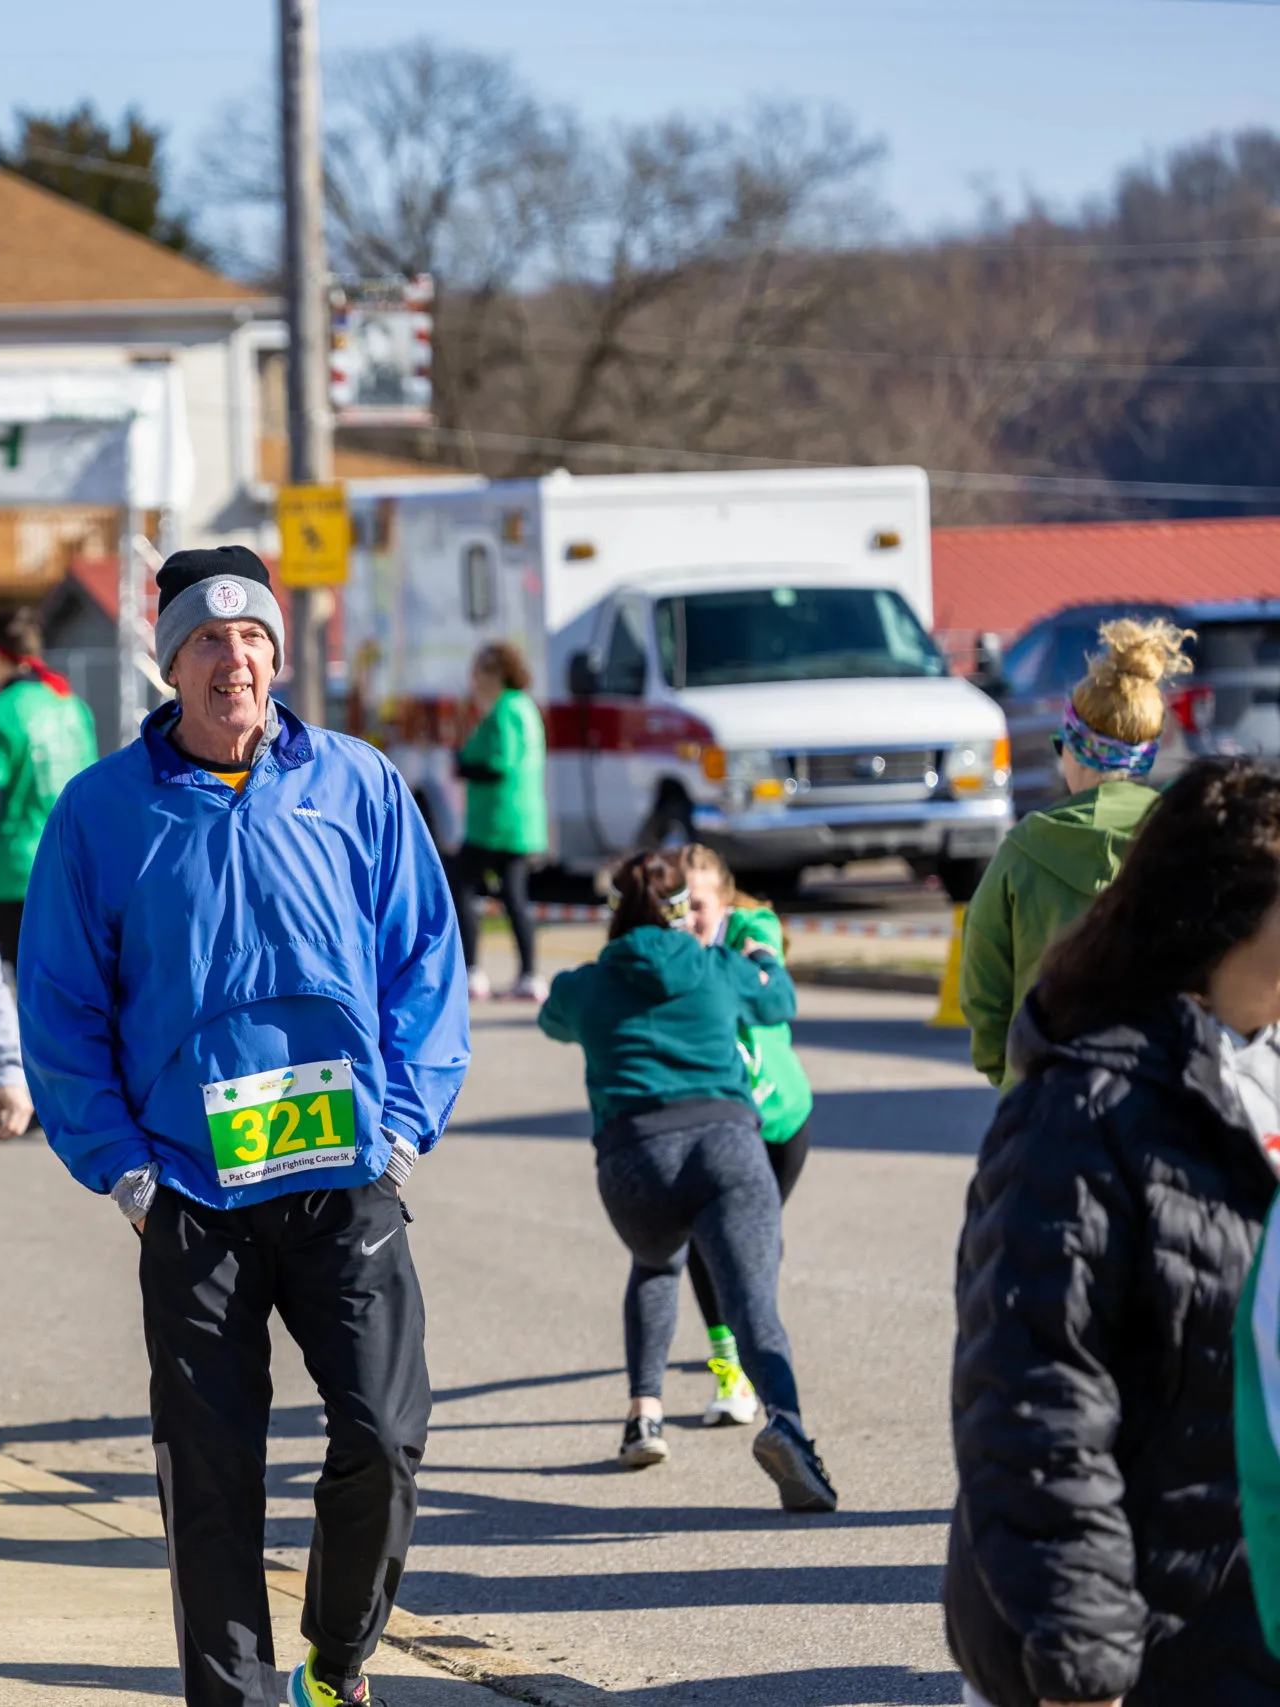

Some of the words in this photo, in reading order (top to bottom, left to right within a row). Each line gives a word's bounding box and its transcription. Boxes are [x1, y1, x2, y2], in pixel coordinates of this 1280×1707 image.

[293, 807, 321, 817] adidas
[231, 1094, 341, 1162] 321
[229, 1173, 244, 1182] Pat
[244, 1163, 282, 1179] Campbell
[282, 1157, 315, 1171] Fighting
[315, 1154, 340, 1164] Cancer
[340, 1152, 350, 1161] 5K
